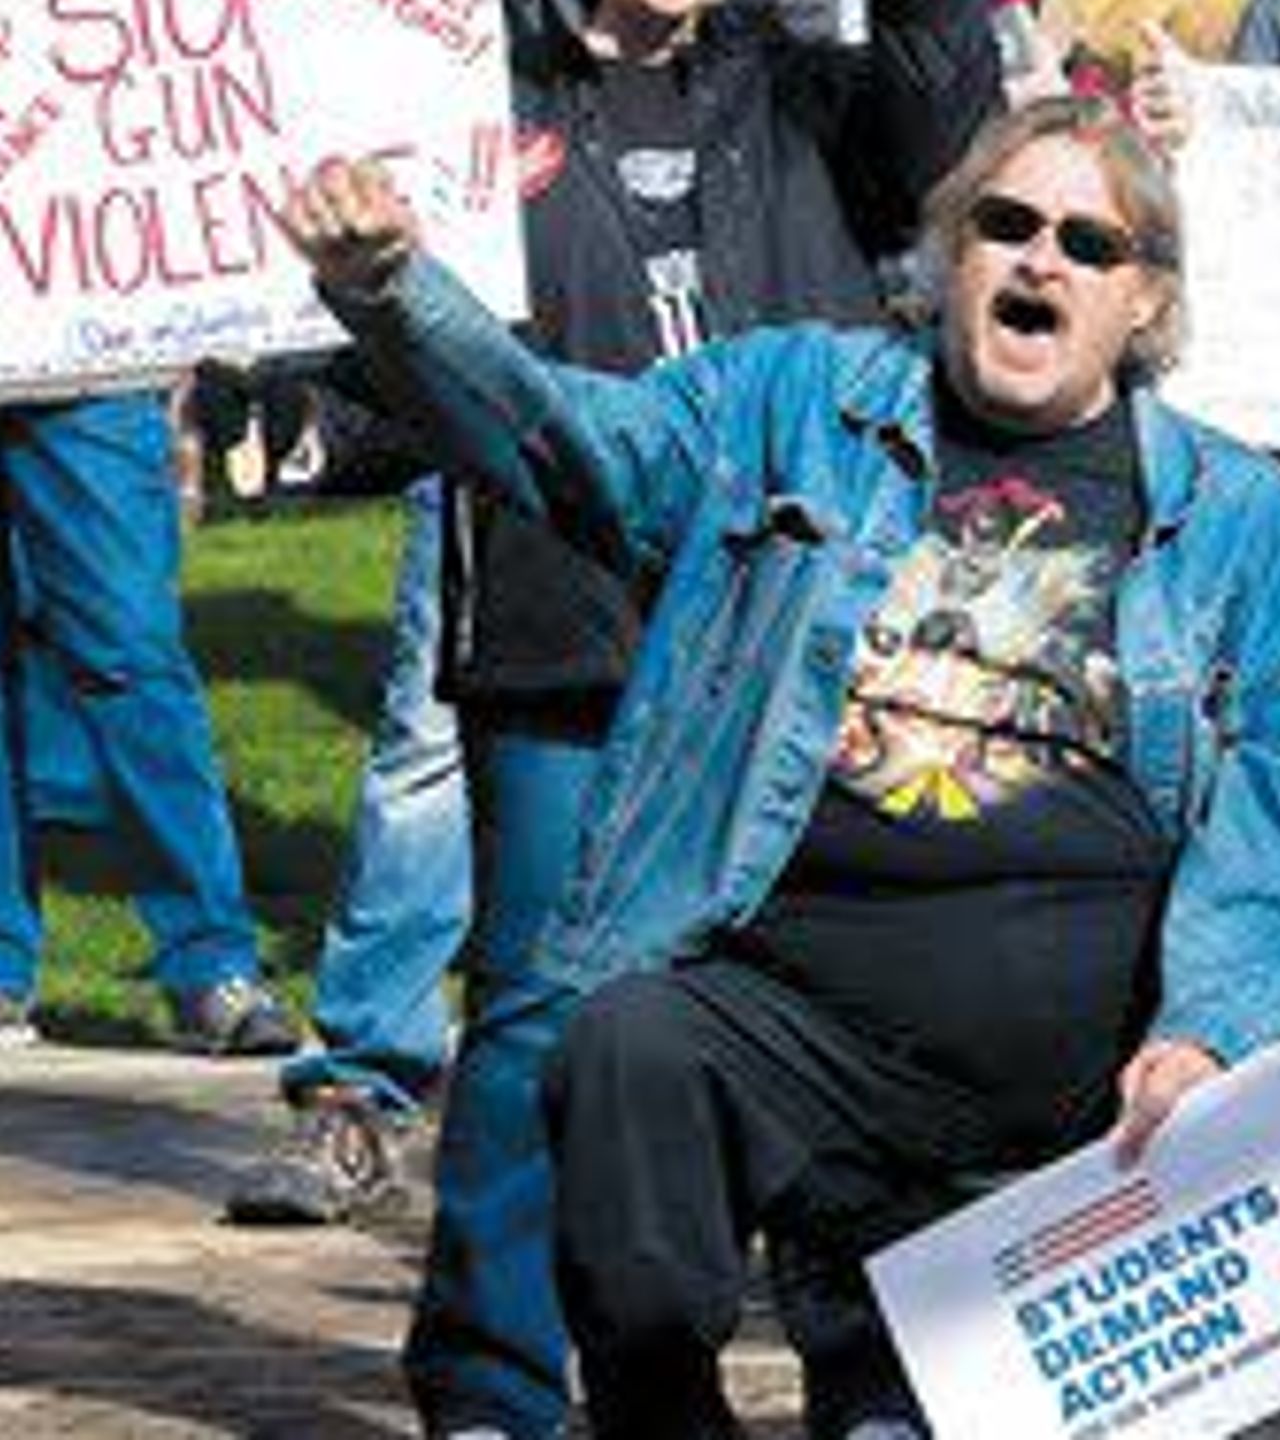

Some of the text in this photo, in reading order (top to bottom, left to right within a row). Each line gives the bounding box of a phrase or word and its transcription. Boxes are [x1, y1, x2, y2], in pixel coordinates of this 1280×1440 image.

[96, 67, 280, 165] GUN
[1015, 1182, 1280, 1340] STUDENTS
[1033, 1248, 1251, 1379] DEMAND
[1060, 1301, 1245, 1420] ACTION
